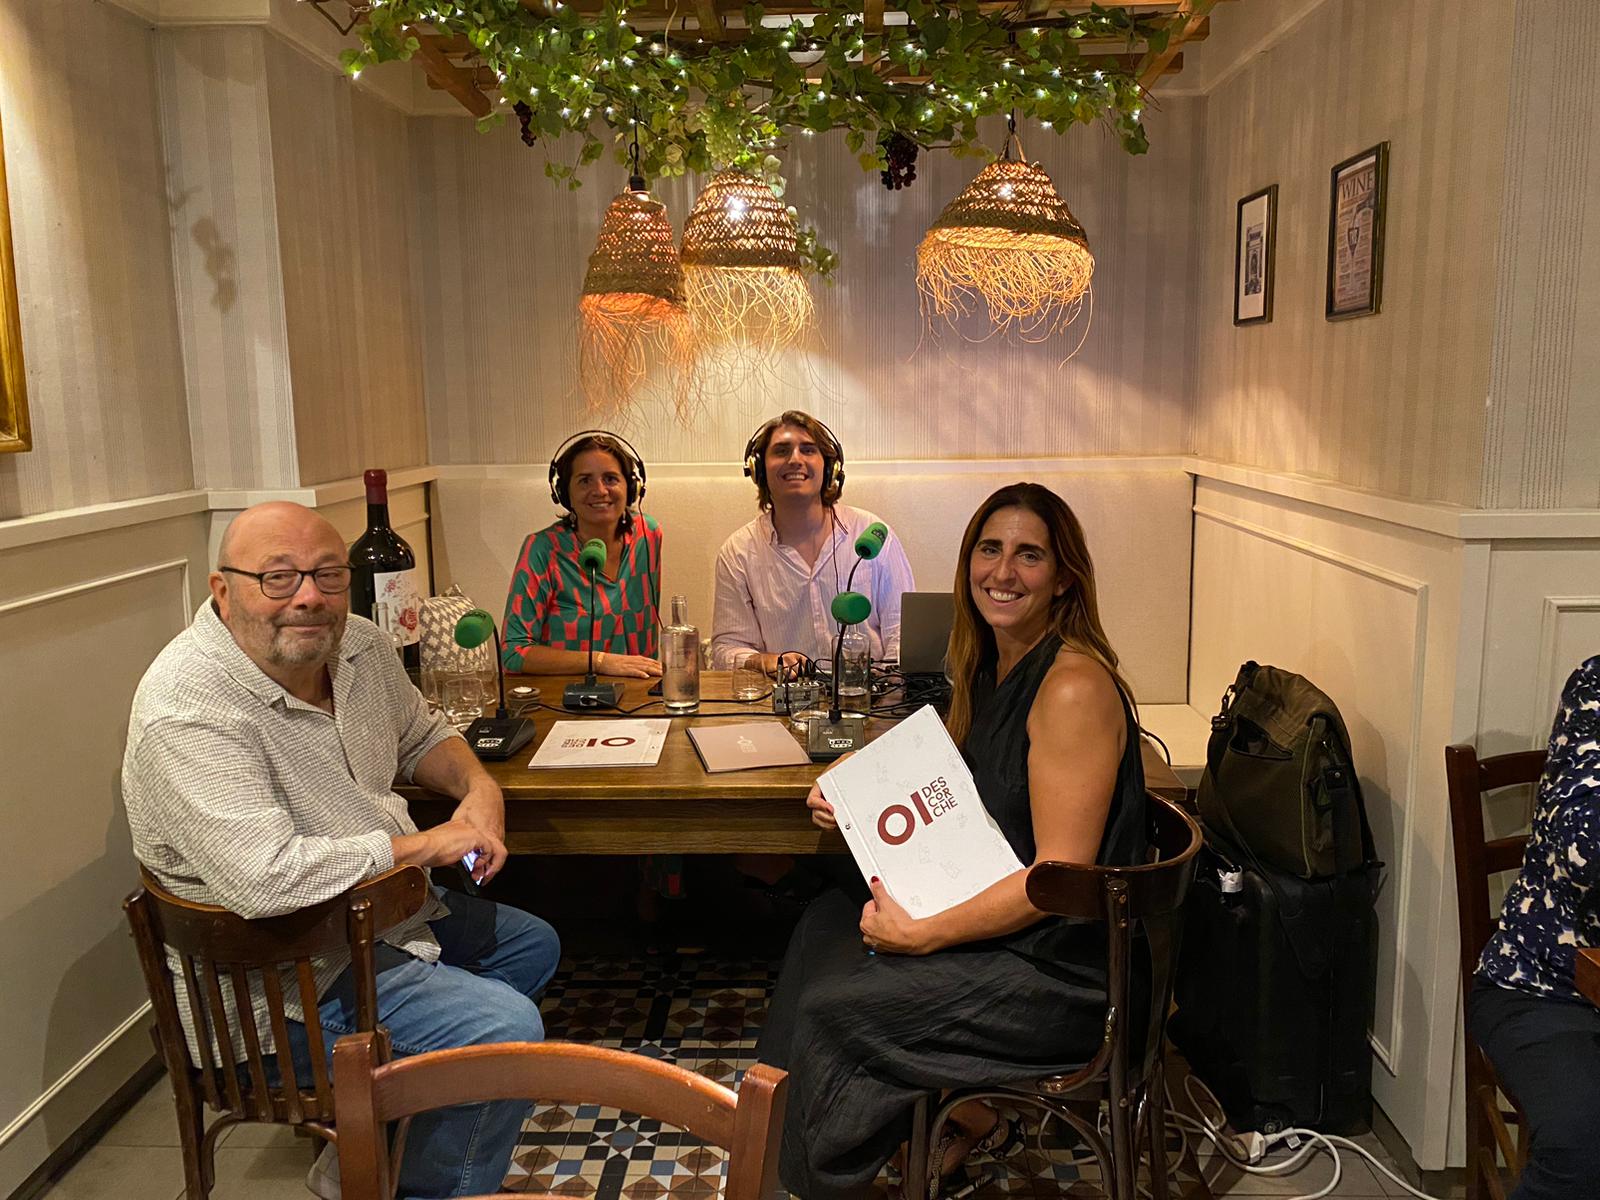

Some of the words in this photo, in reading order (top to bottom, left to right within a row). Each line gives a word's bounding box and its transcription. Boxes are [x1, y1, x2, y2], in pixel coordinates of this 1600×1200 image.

[1342, 171, 1374, 199] WINE
[921, 776, 947, 798] DES
[928, 787, 953, 808] COR
[933, 796, 958, 817] CHE
